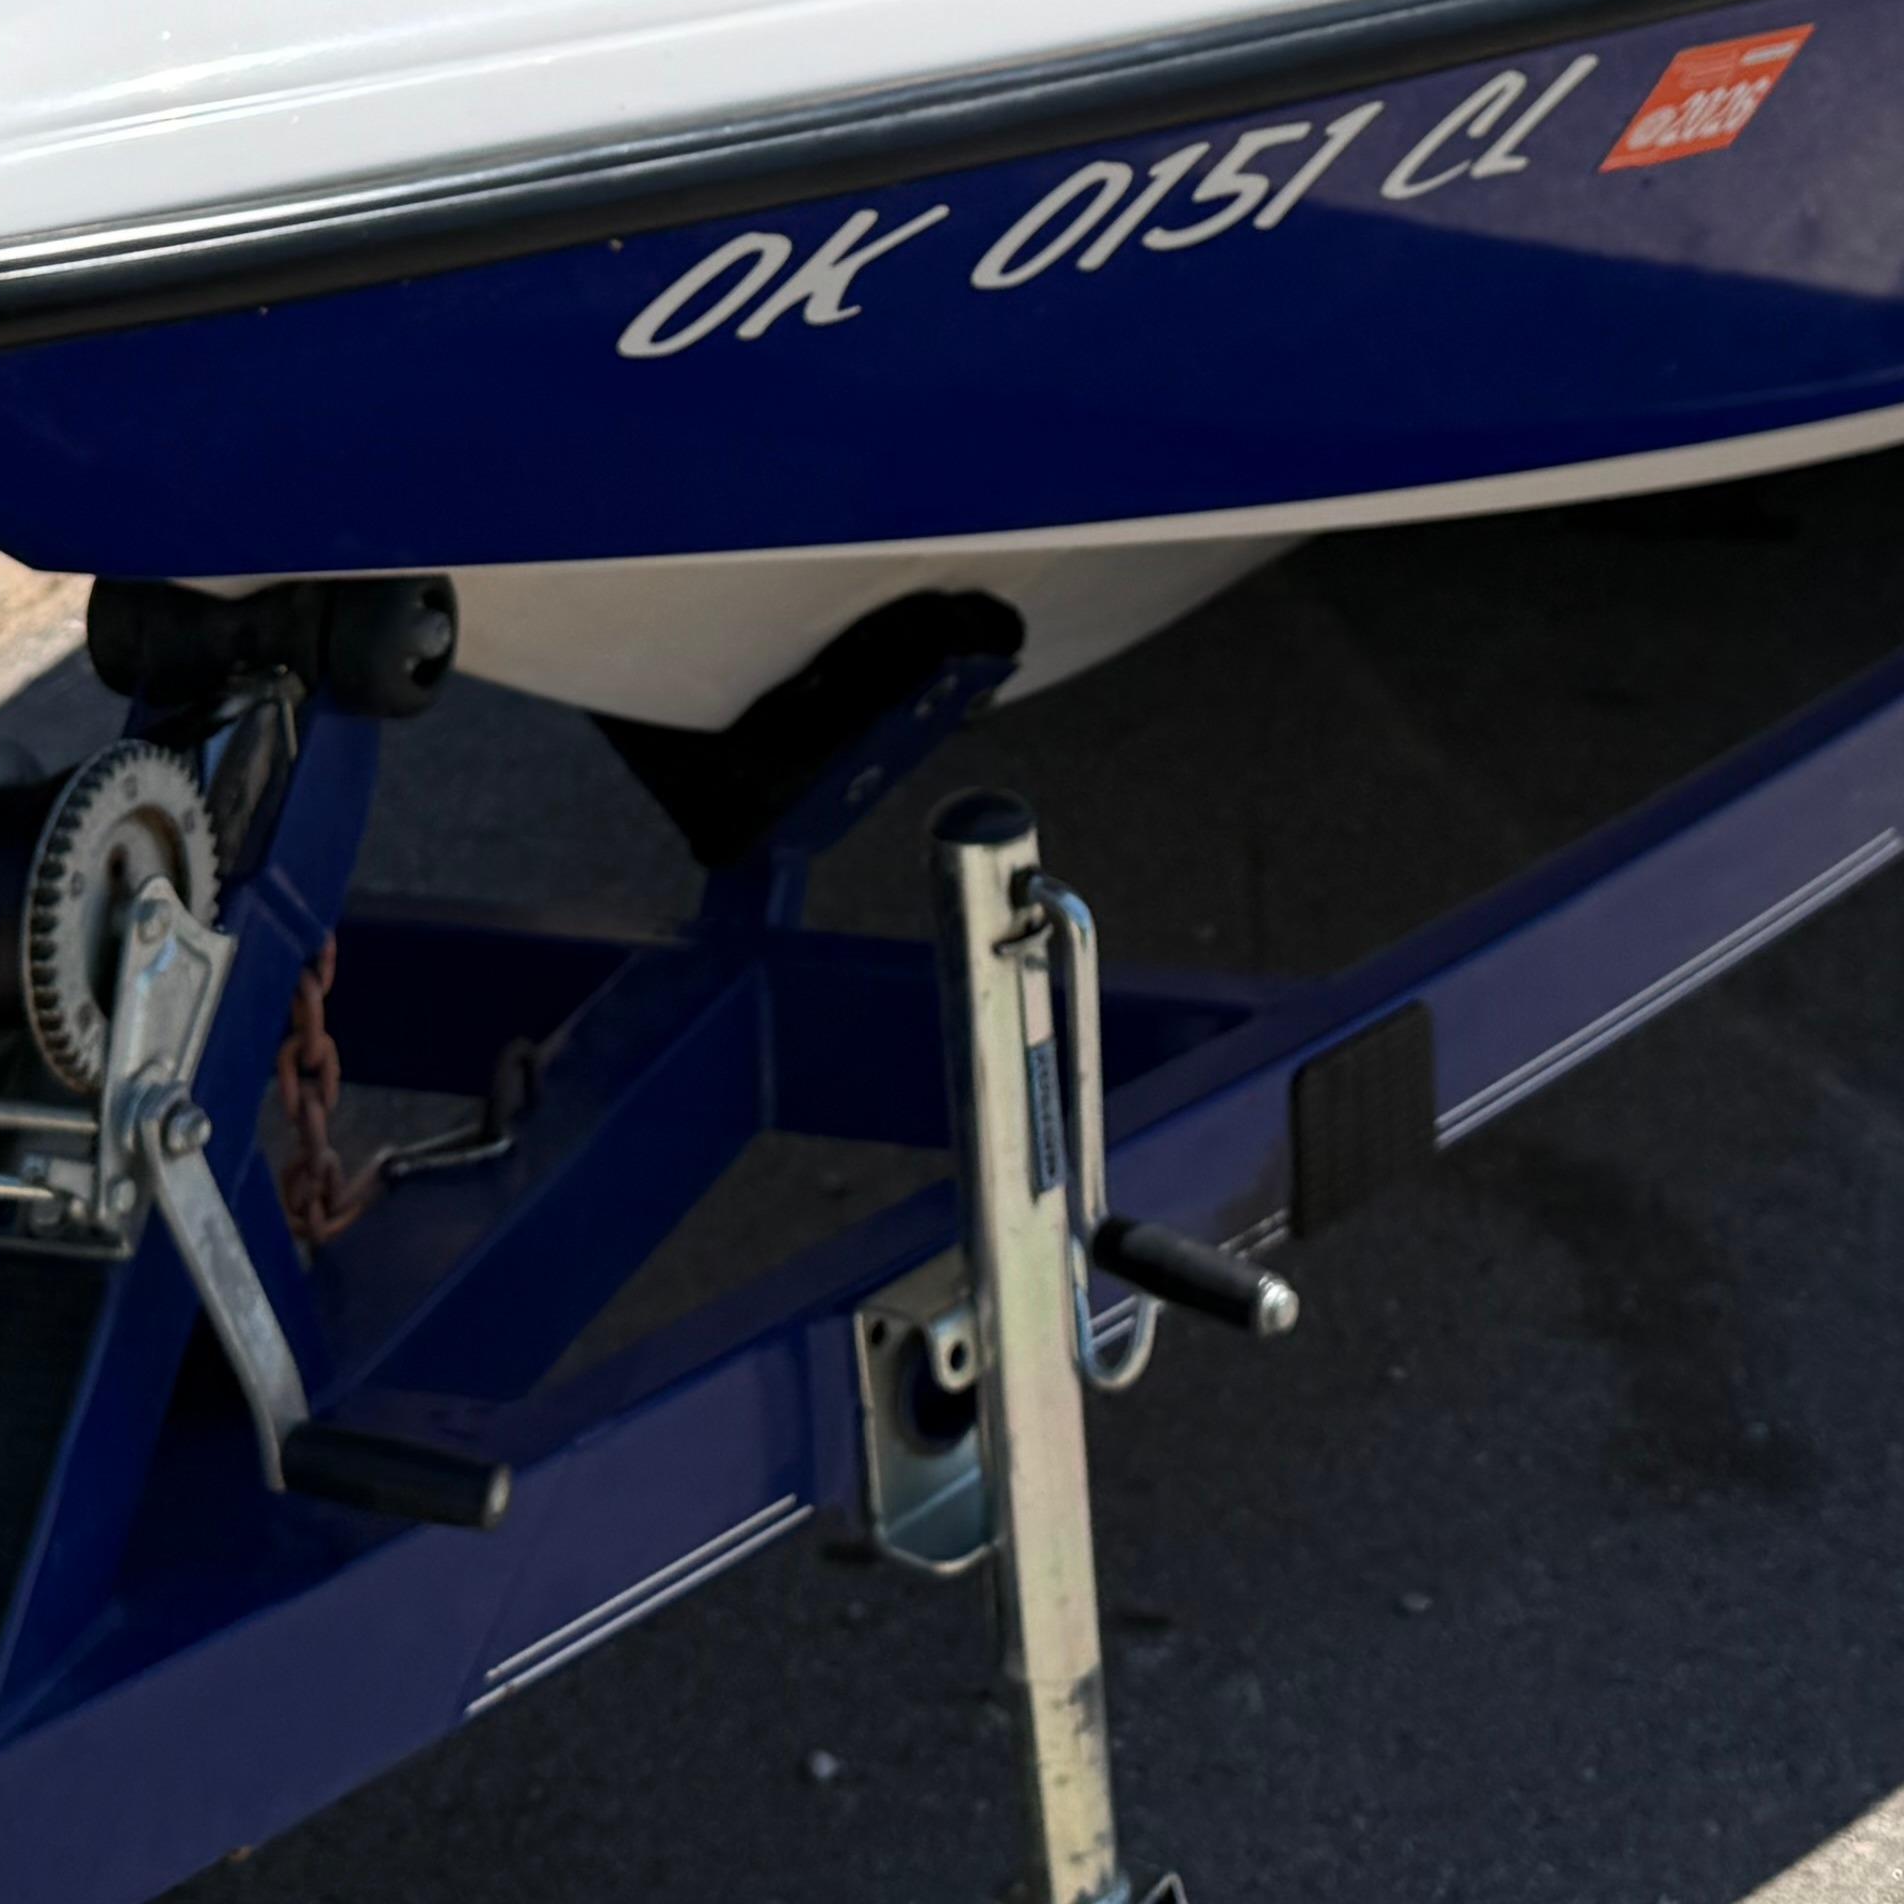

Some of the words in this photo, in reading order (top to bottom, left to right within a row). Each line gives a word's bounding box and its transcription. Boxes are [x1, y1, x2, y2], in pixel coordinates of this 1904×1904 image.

[618, 205, 949, 357] OK
[972, 101, 1384, 288] 0151
[1380, 53, 1599, 200] CL
